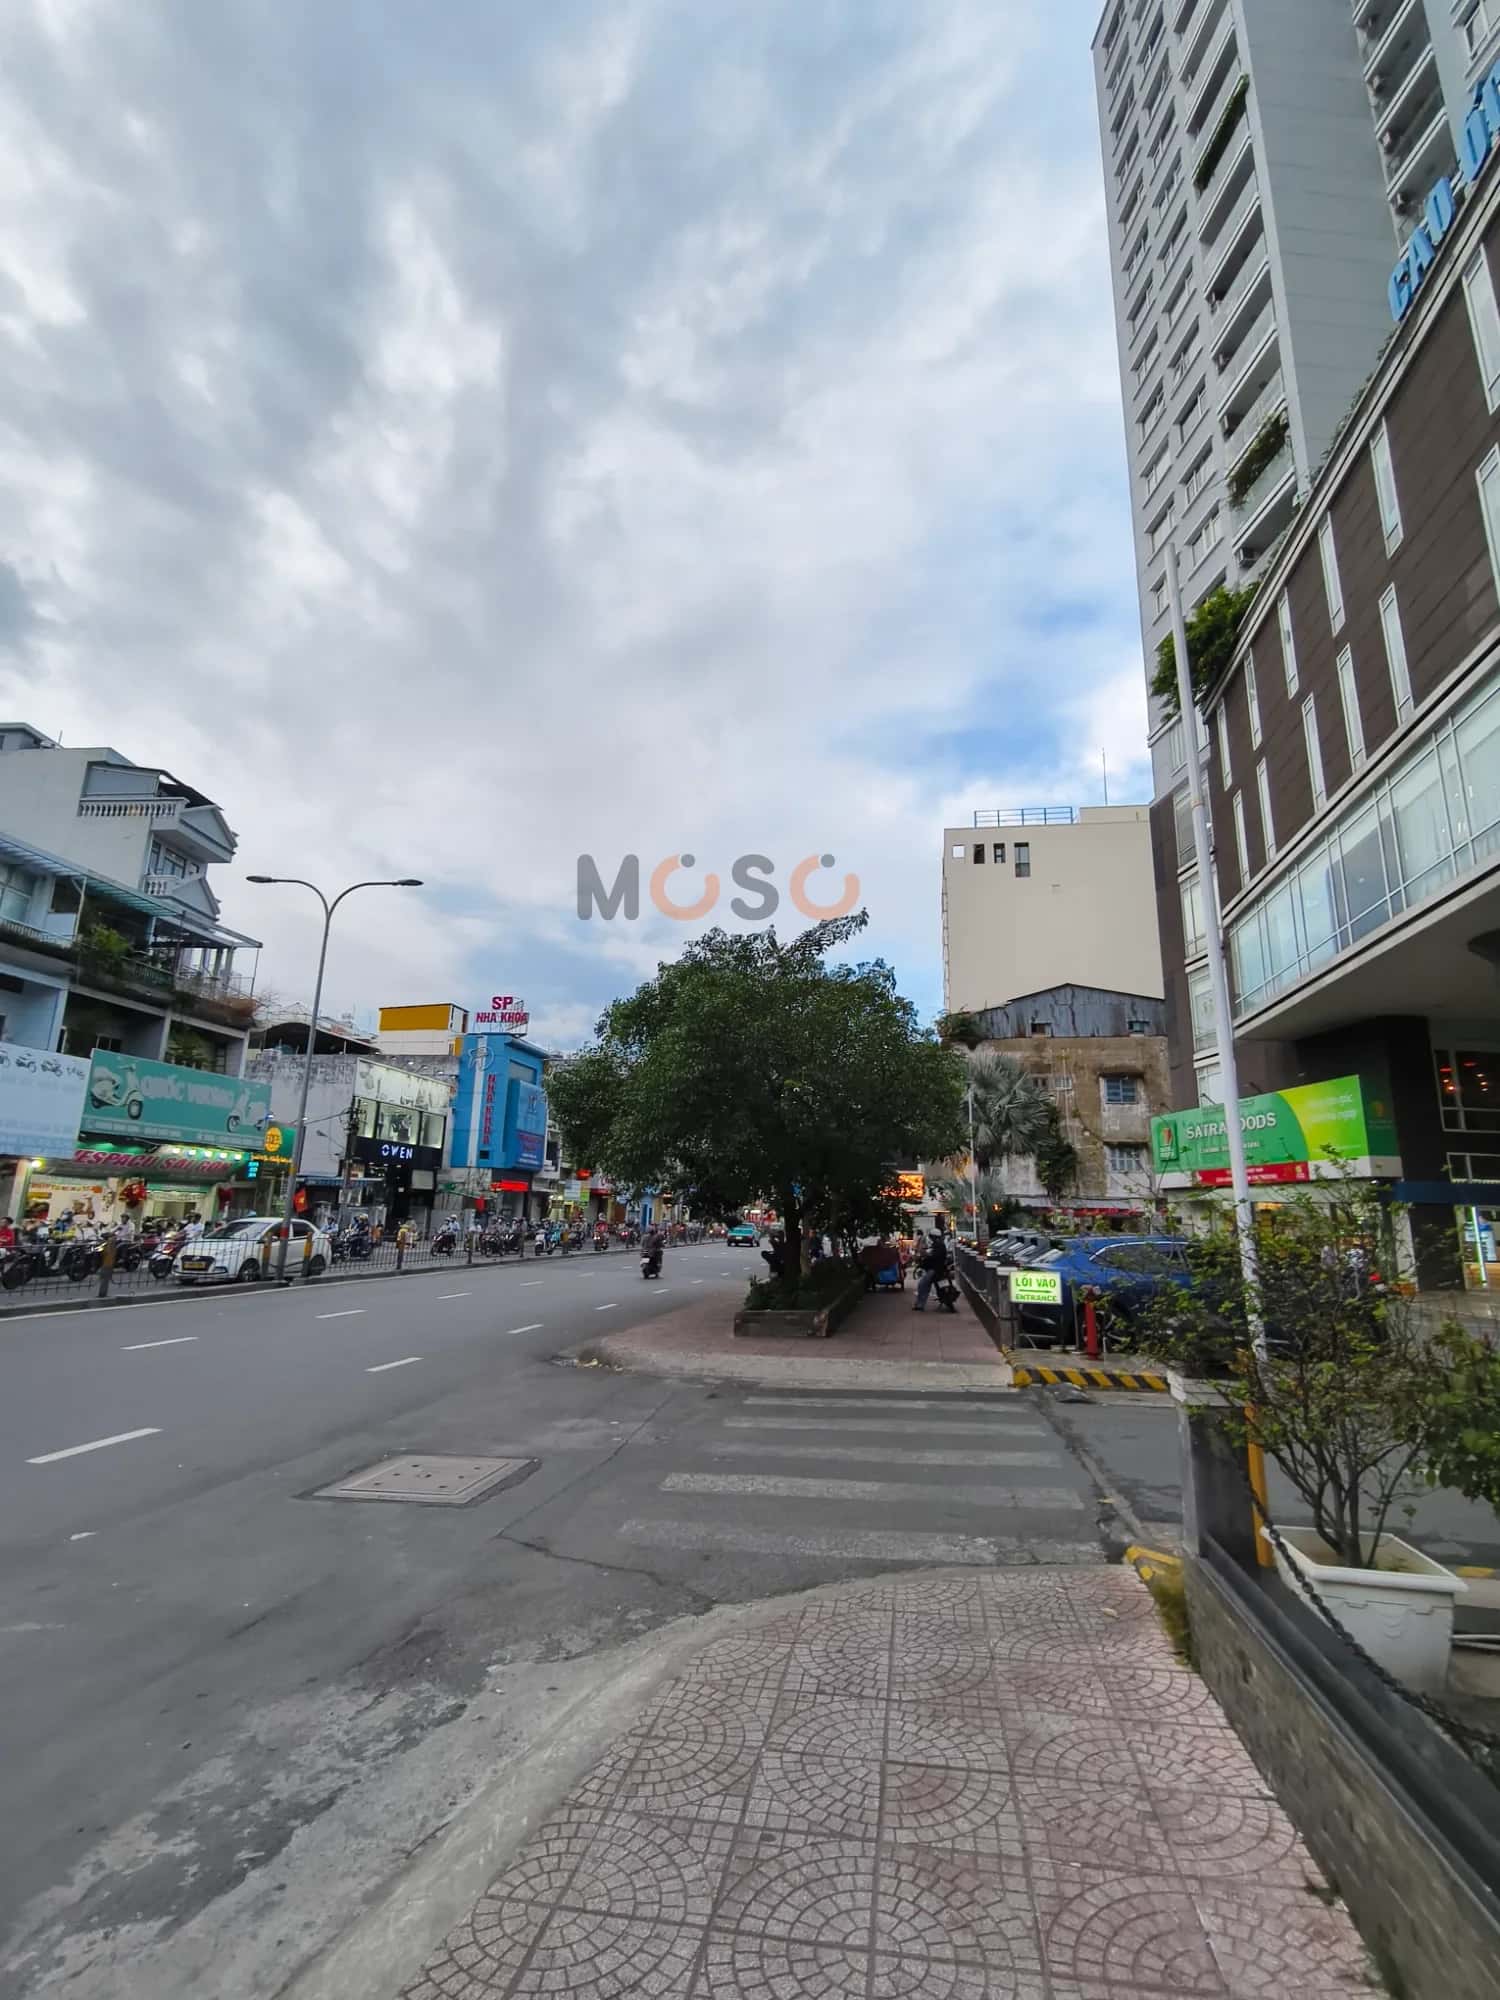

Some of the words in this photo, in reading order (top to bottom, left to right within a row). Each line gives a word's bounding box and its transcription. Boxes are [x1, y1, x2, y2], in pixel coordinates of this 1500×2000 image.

[491, 996, 514, 1010] SP
[476, 1012, 497, 1023] NHA
[1015, 1293, 1057, 1302] ENTRANCE
